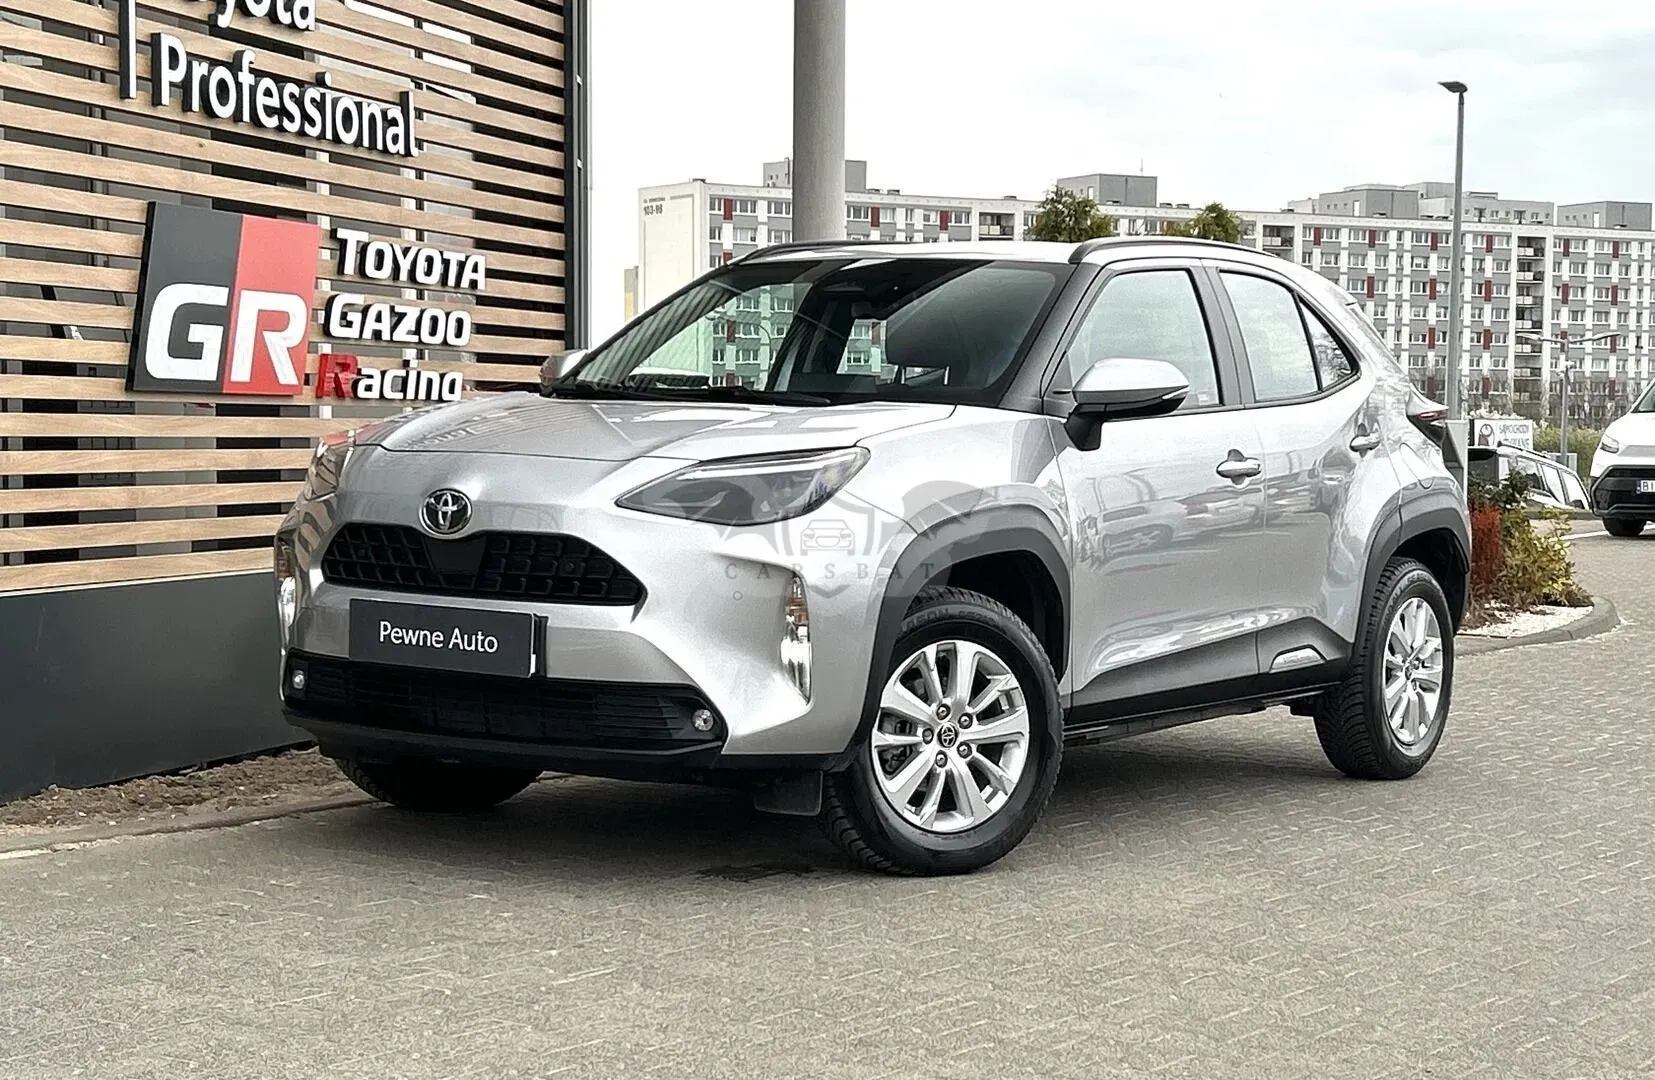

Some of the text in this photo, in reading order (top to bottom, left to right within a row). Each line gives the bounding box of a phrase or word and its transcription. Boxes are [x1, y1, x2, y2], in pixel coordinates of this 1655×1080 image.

[159, 33, 419, 157] Professional
[336, 228, 487, 290] TOYOTA
[145, 283, 308, 386] GR
[329, 293, 472, 346] GAZOO
[379, 620, 498, 653] Pewne Auto
